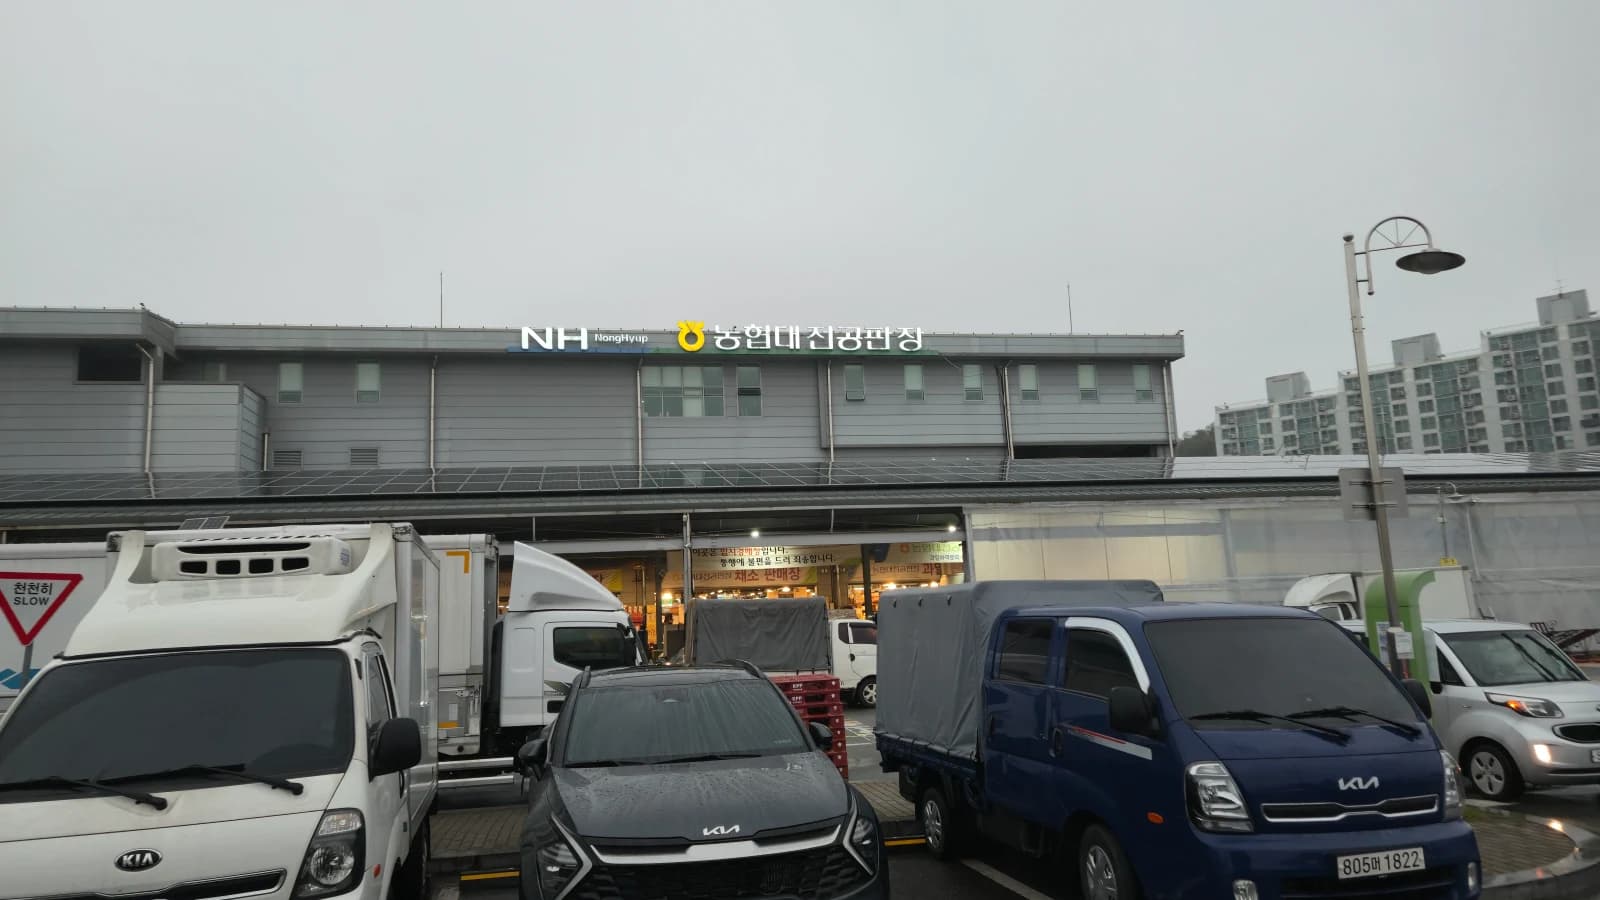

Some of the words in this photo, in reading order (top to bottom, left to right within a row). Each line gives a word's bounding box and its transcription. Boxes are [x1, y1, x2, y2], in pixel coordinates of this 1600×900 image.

[521, 326, 588, 350] NH
[594, 333, 649, 344] NongHyup
[748, 557, 772, 567] 불편을
[734, 568, 760, 583] 채소
[764, 567, 801, 581] 판매장
[13, 582, 53, 596] 천천히
[13, 596, 50, 606] SLOW
[1343, 856, 1381, 876] 805머
[1384, 851, 1421, 871] 1822
